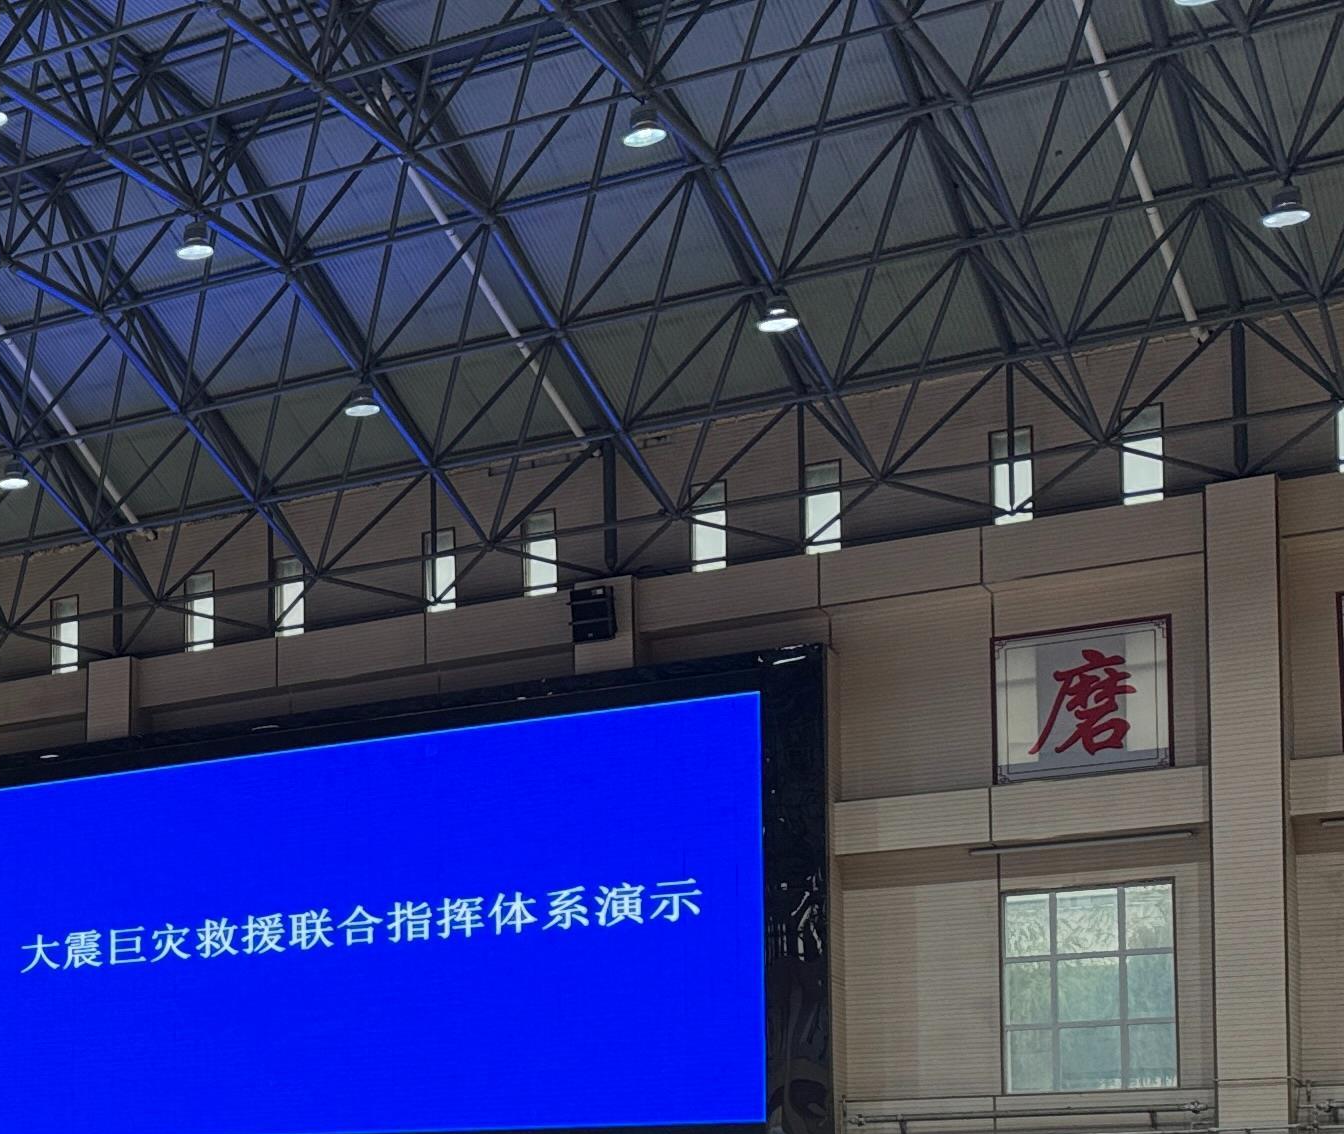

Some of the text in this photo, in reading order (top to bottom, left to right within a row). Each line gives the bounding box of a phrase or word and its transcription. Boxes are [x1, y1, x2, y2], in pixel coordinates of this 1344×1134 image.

[19, 877, 704, 975] 大震巨灾救援联合指挥体系演示
